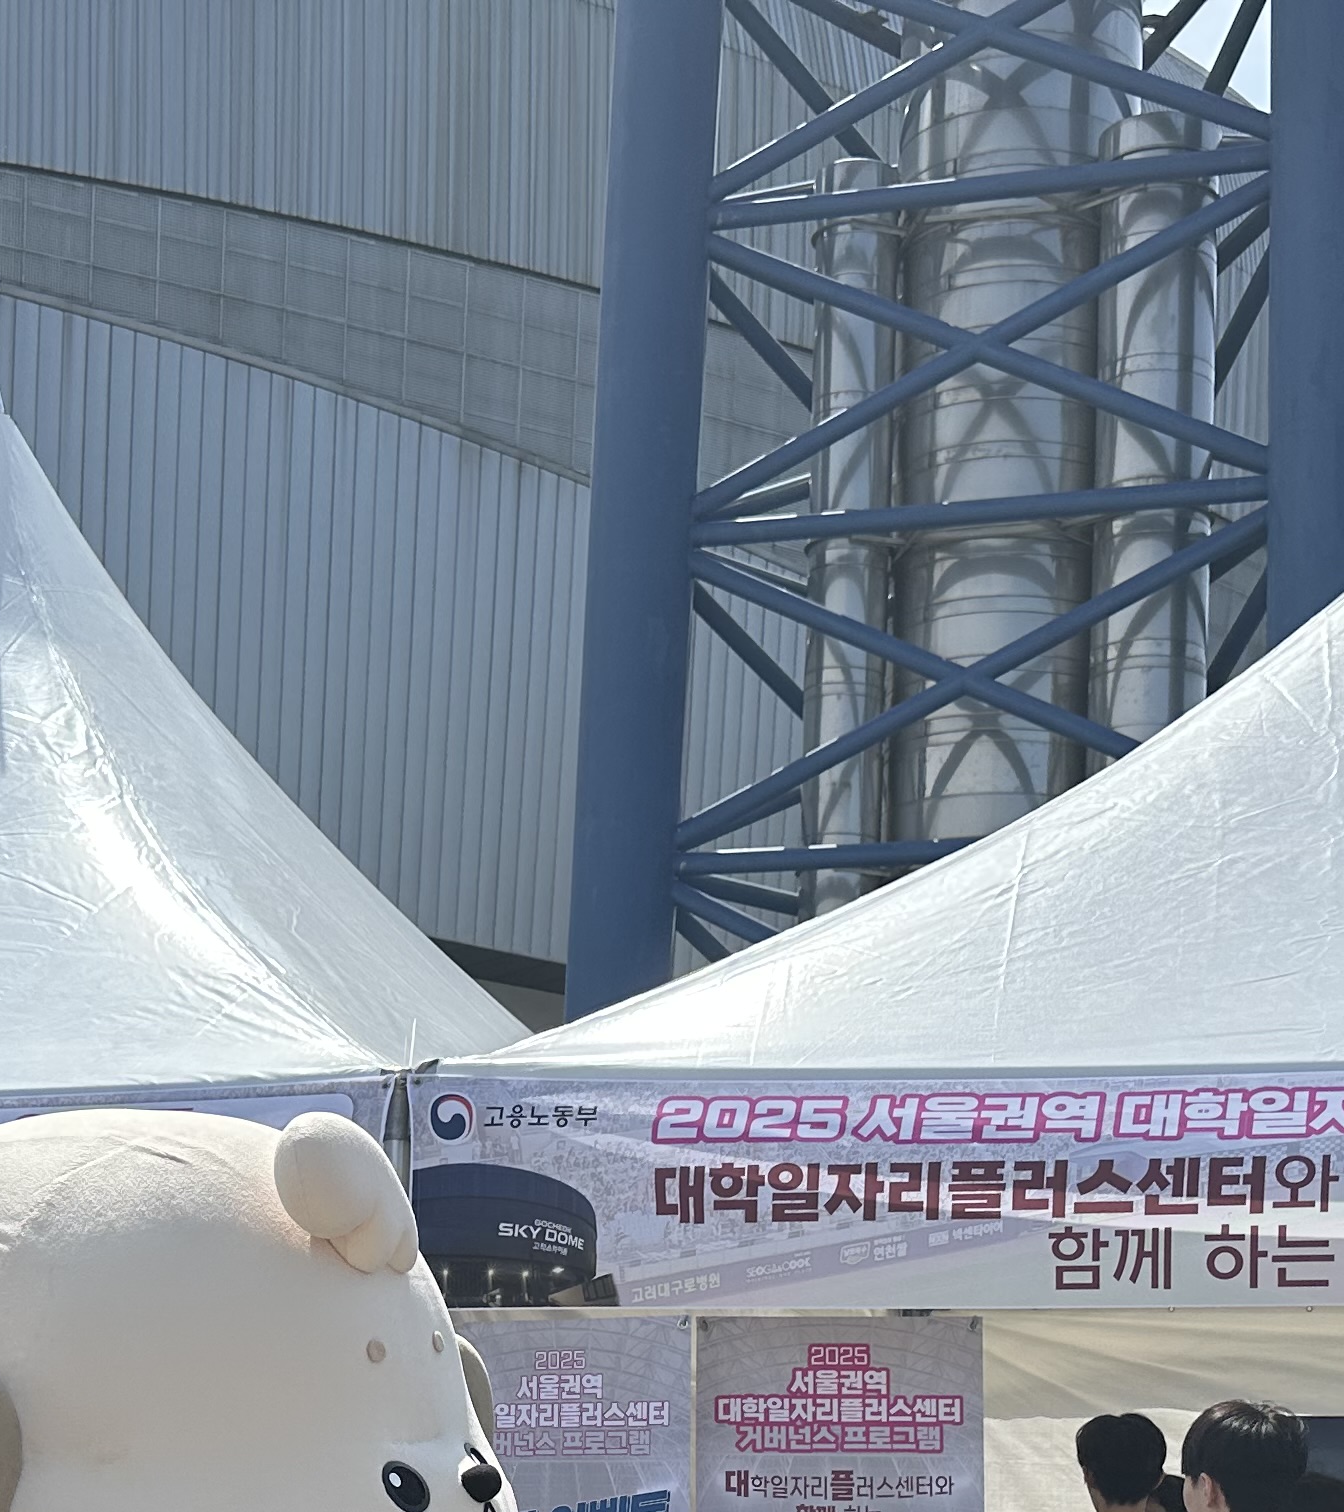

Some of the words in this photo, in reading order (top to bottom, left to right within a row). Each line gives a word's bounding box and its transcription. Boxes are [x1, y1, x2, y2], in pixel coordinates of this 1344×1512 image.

[483, 1105, 598, 1130] 고용노동부
[651, 1096, 847, 1145] 2025
[851, 1091, 1106, 1145] 서울권역
[656, 1154, 1339, 1224] 대학일자리플러스센터와
[498, 1222, 542, 1239] SKY
[545, 1229, 584, 1250] DOME
[1049, 1225, 1172, 1290] 함께
[1204, 1224, 1335, 1288] 하는
[535, 1350, 586, 1370] 2025
[809, 1344, 869, 1367] 2025
[516, 1374, 603, 1400] 서울권역
[787, 1368, 889, 1396] 서울권역
[493, 1400, 670, 1429] 일자리플러스센터
[715, 1395, 963, 1425] 대학일자리플러스센터
[493, 1431, 556, 1456] 버넌스
[561, 1429, 652, 1456] 프로그램
[736, 1425, 839, 1453] 거버넌스
[840, 1425, 944, 1453] 프로그램
[725, 1470, 954, 1501] 대학일자리플러스센터와
